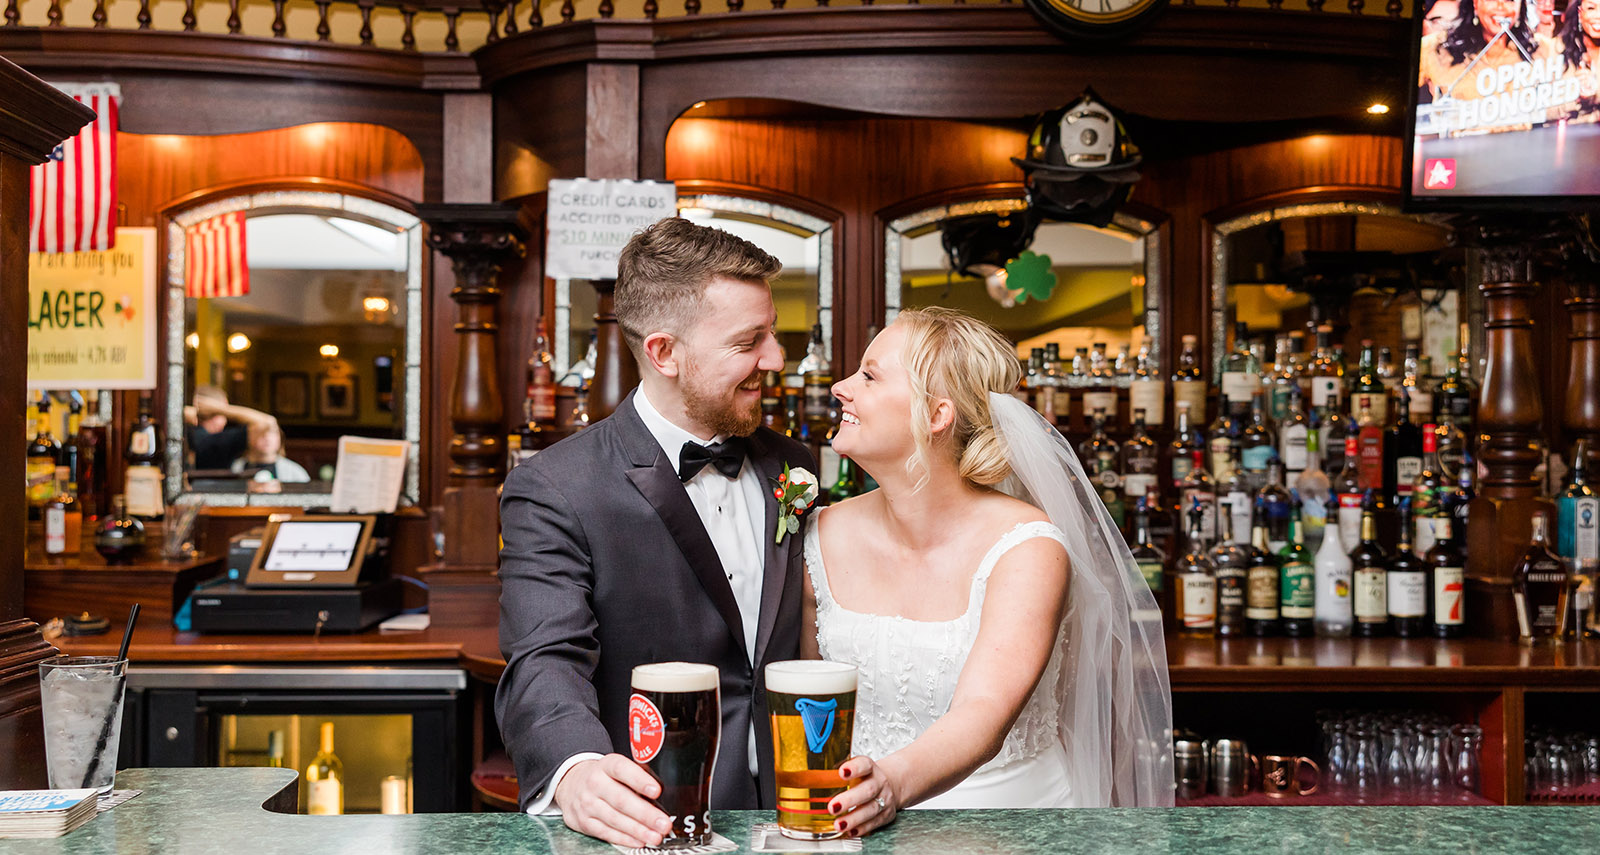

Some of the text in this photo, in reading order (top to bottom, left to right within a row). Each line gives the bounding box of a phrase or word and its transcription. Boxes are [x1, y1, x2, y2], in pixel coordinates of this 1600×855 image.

[1476, 54, 1565, 96] OPRAH
[1457, 77, 1581, 129] HONORED
[560, 193, 666, 209] CREDIT CARDS
[560, 212, 621, 225] ACCEPTED
[112, 252, 134, 276] you
[28, 290, 104, 331] LAGER
[1443, 581, 1464, 620] 7
[639, 745, 654, 759] ALE
